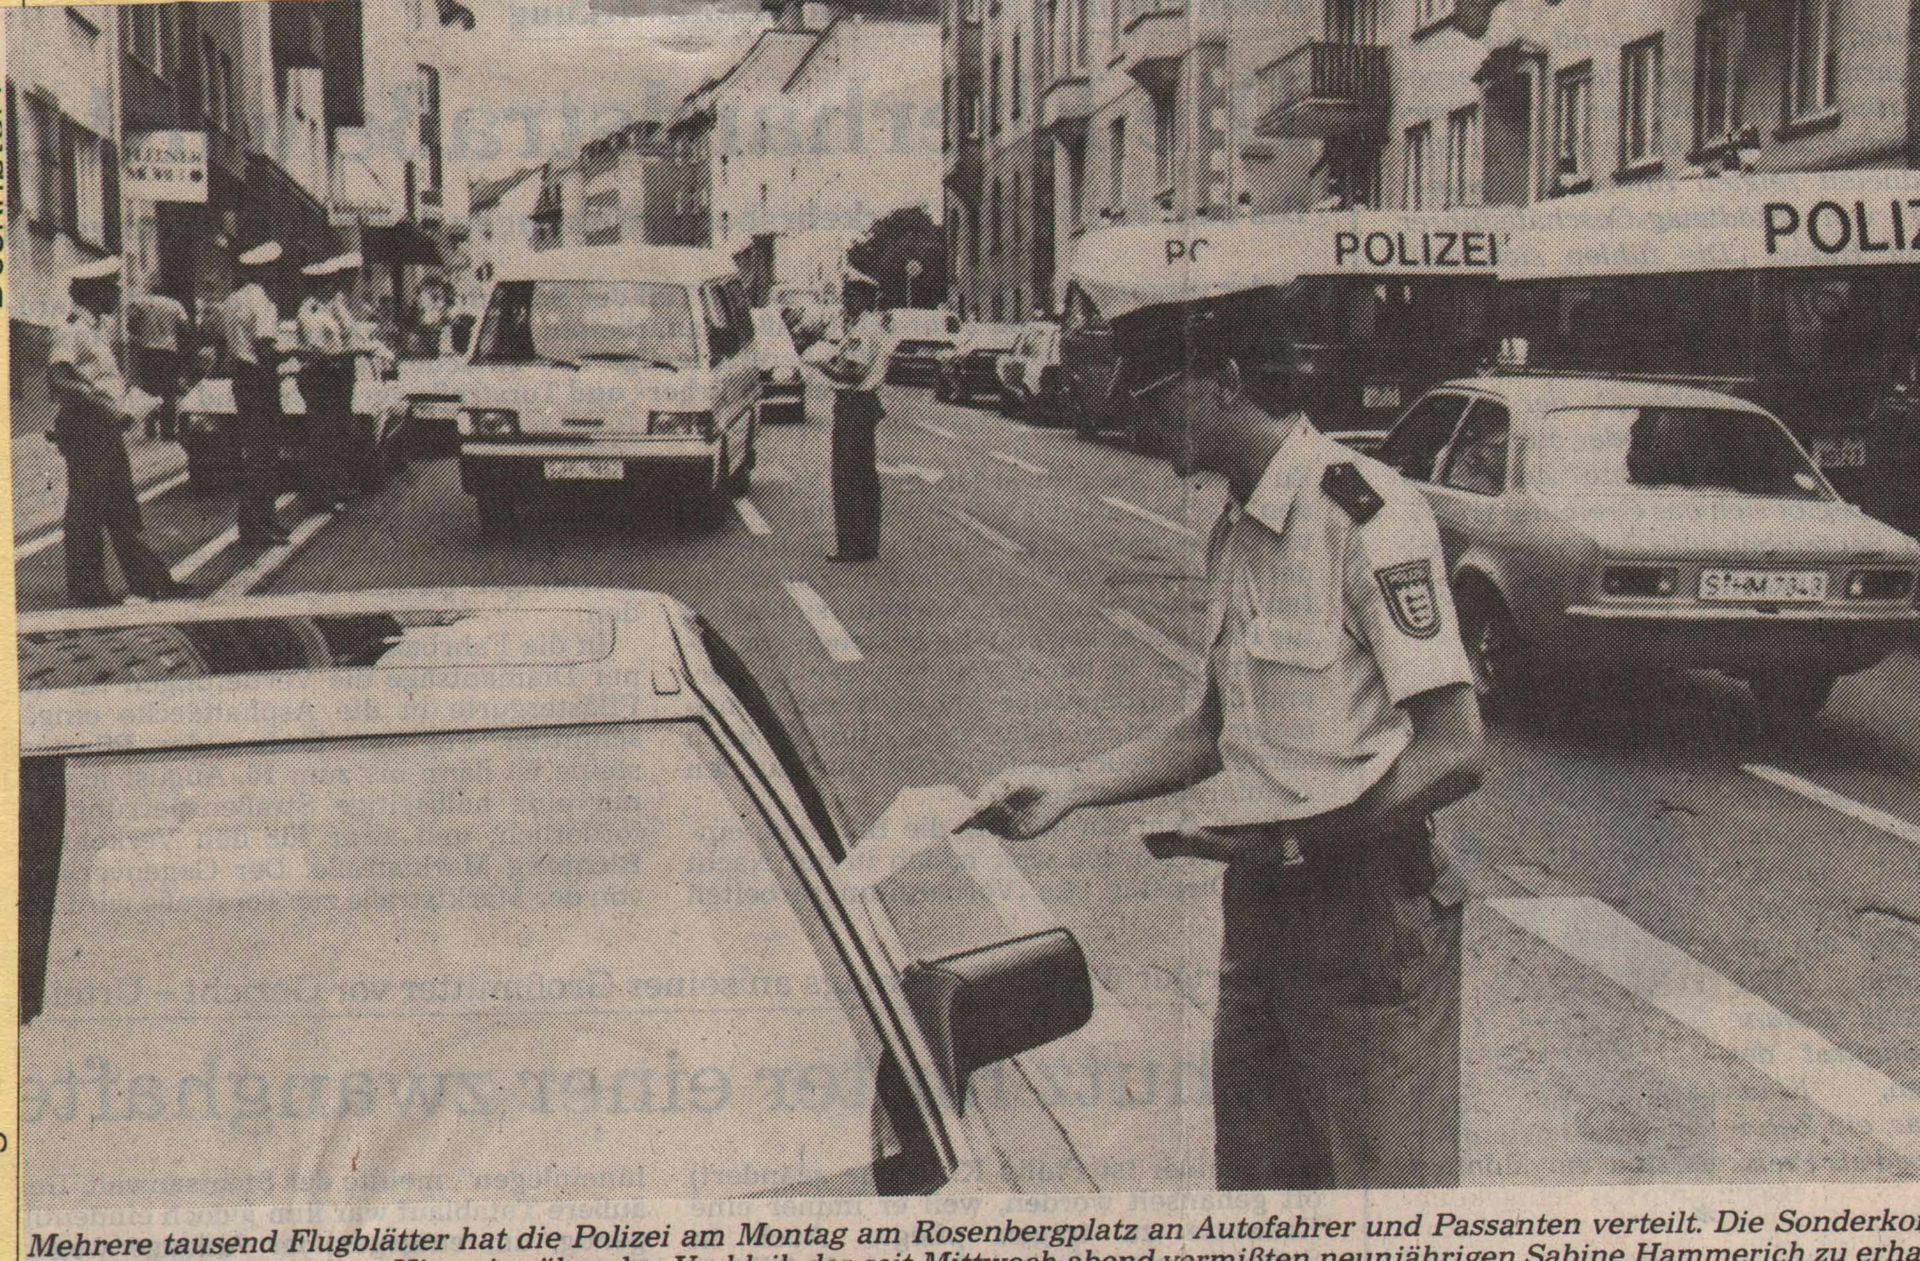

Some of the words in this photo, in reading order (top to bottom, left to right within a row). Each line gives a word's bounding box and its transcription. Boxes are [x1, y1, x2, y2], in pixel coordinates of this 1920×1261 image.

[1335, 231, 1498, 267] POLIZEI
[28, 1233, 152, 1257] Mehrere
[165, 1230, 277, 1255] tausend
[288, 1229, 449, 1257] Flugblätter
[459, 1227, 507, 1249] hat
[518, 1226, 561, 1249] die
[572, 1225, 670, 1248] Polizei
[682, 1230, 724, 1247] am
[737, 1223, 848, 1250] Montag
[858, 1228, 900, 1244] am
[913, 1218, 1138, 1247] Rosenbergplatz
[1149, 1224, 1182, 1240] an
[1193, 1215, 1356, 1239] Autofahrer
[1367, 1214, 1422, 1236] und
[1433, 1214, 1580, 1236] Passanten
[1594, 1211, 1701, 1234] verteilt.
[1715, 1211, 1764, 1232] Die
